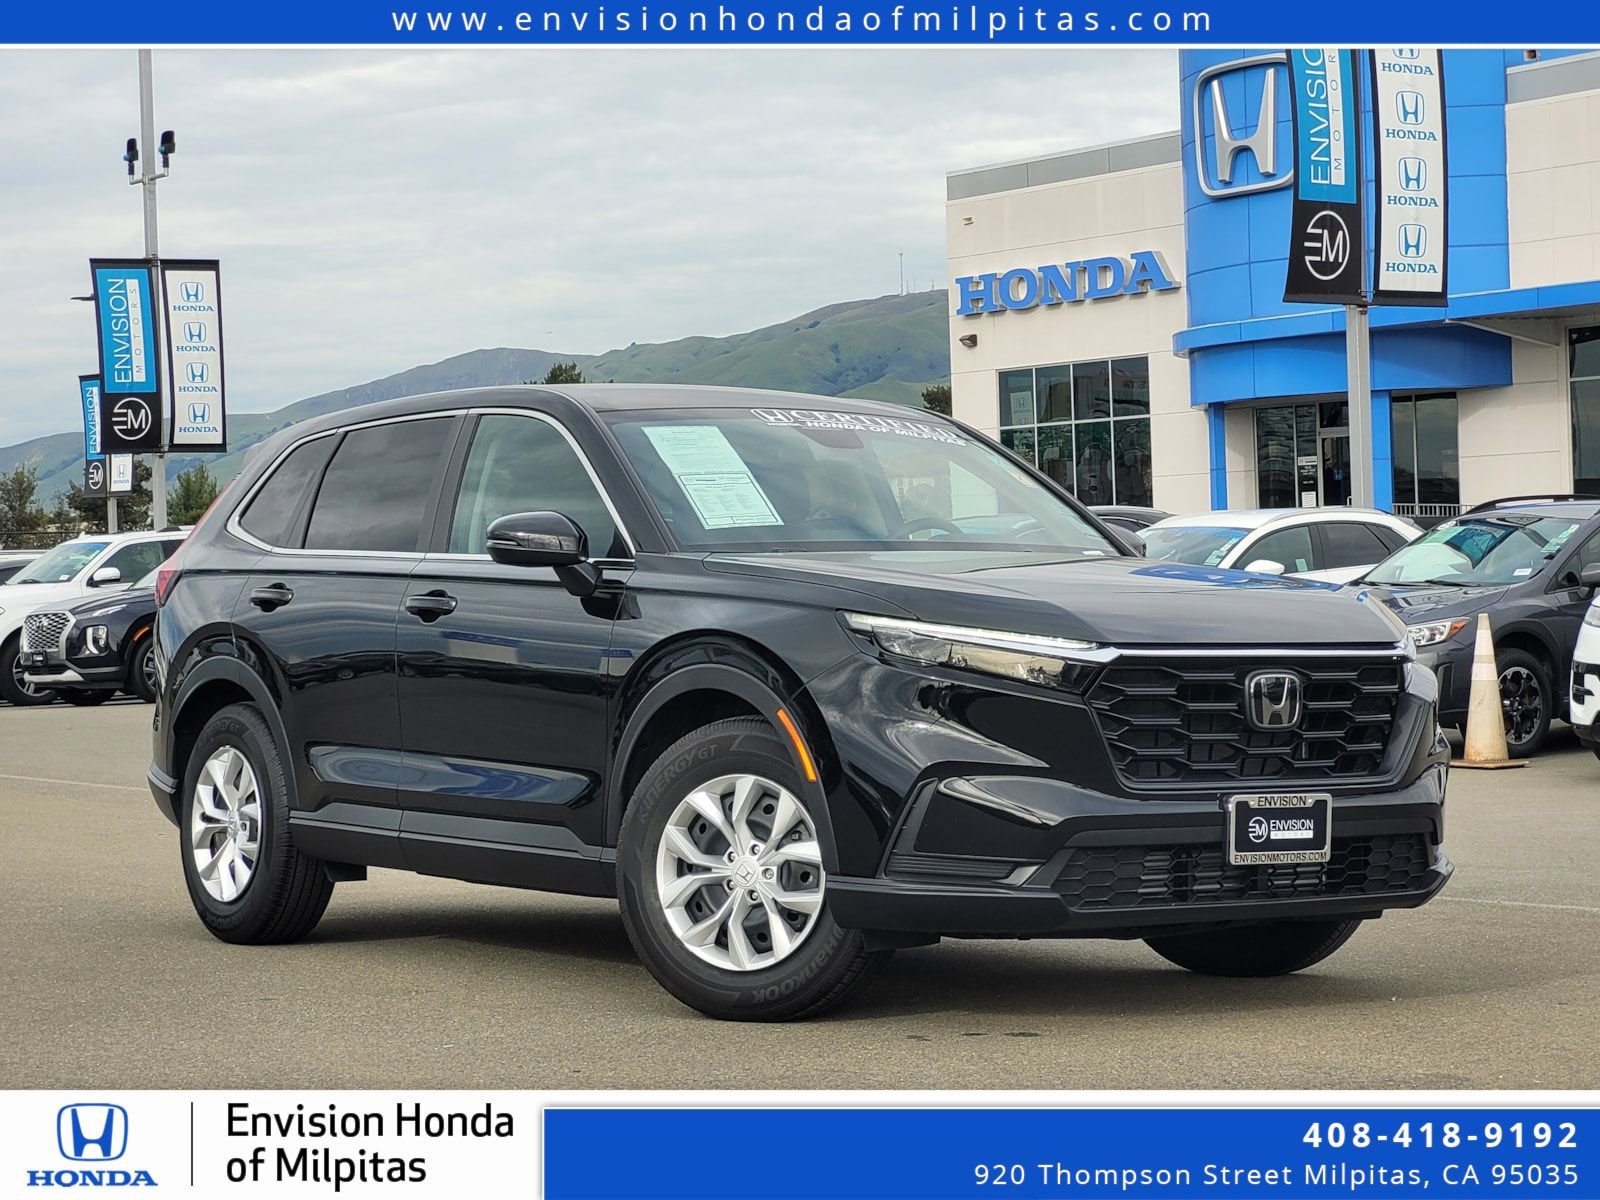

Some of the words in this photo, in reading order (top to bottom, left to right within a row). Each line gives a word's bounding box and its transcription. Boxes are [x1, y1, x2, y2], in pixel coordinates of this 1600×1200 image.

[1381, 62, 1434, 76] HONDA
[1302, 48, 1330, 184] ENVISIO
[1328, 54, 1342, 171] MOTOR
[1385, 128, 1438, 142] HONDA
[1387, 195, 1439, 208] HONDA
[1385, 262, 1438, 274] HONDA
[955, 250, 1178, 316] HONDA
[172, 304, 215, 312] HONDA
[108, 278, 132, 383] ENVISION
[130, 288, 143, 374] MOTORS
[176, 344, 216, 352] HONDA
[178, 385, 218, 393] HONDA
[86, 387, 97, 453] ENVISION
[790, 409, 959, 439] CERTIFIED
[178, 425, 218, 433] HONDA
[806, 421, 866, 431] HONDA
[895, 429, 967, 447] MILPITAS
[698, 744, 718, 760] GT
[1257, 795, 1307, 807] ENVISION
[1269, 819, 1314, 831] ENVISION
[1234, 851, 1327, 864] ENVISIONMOTORS.COM
